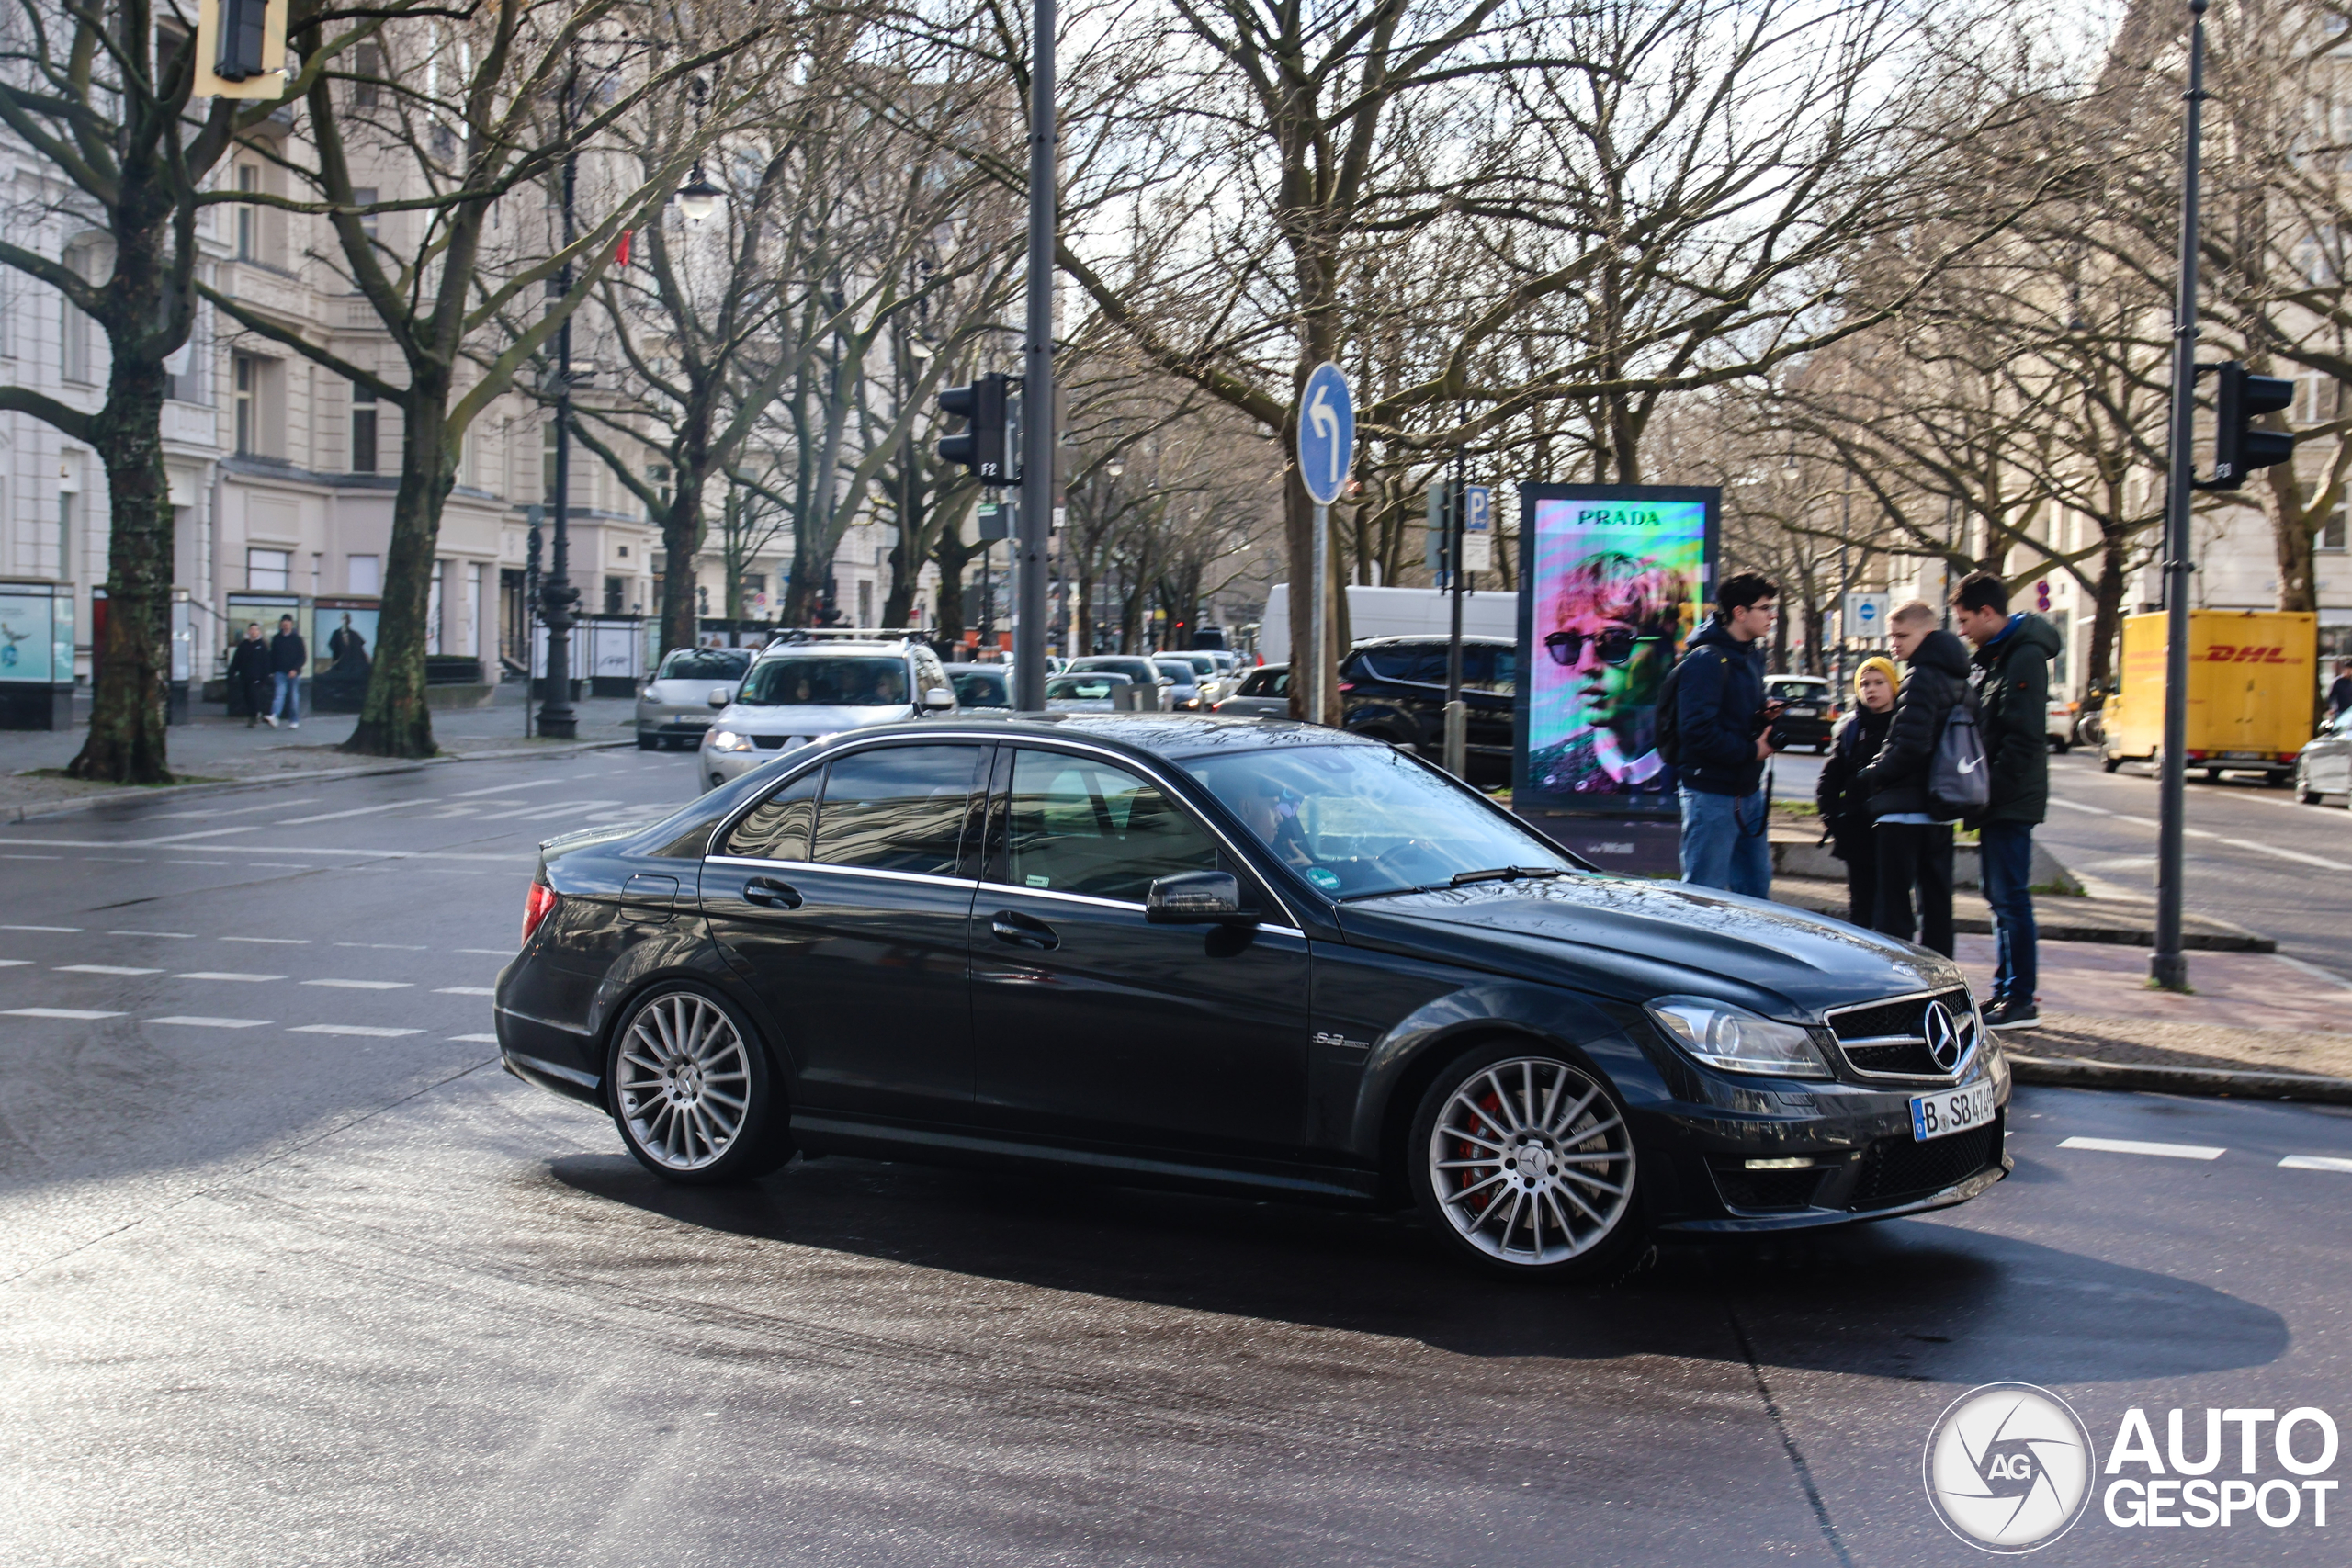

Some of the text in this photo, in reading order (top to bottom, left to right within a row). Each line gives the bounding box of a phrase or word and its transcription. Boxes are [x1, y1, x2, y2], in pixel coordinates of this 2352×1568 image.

[980, 462, 998, 477] F2
[1470, 491, 1486, 525] P
[1577, 509, 1661, 526] PRADA
[2206, 645, 2287, 663] DHL
[1924, 1101, 1939, 1133] B
[1950, 1094, 1972, 1126] SB
[1917, 1122, 1923, 1134] D
